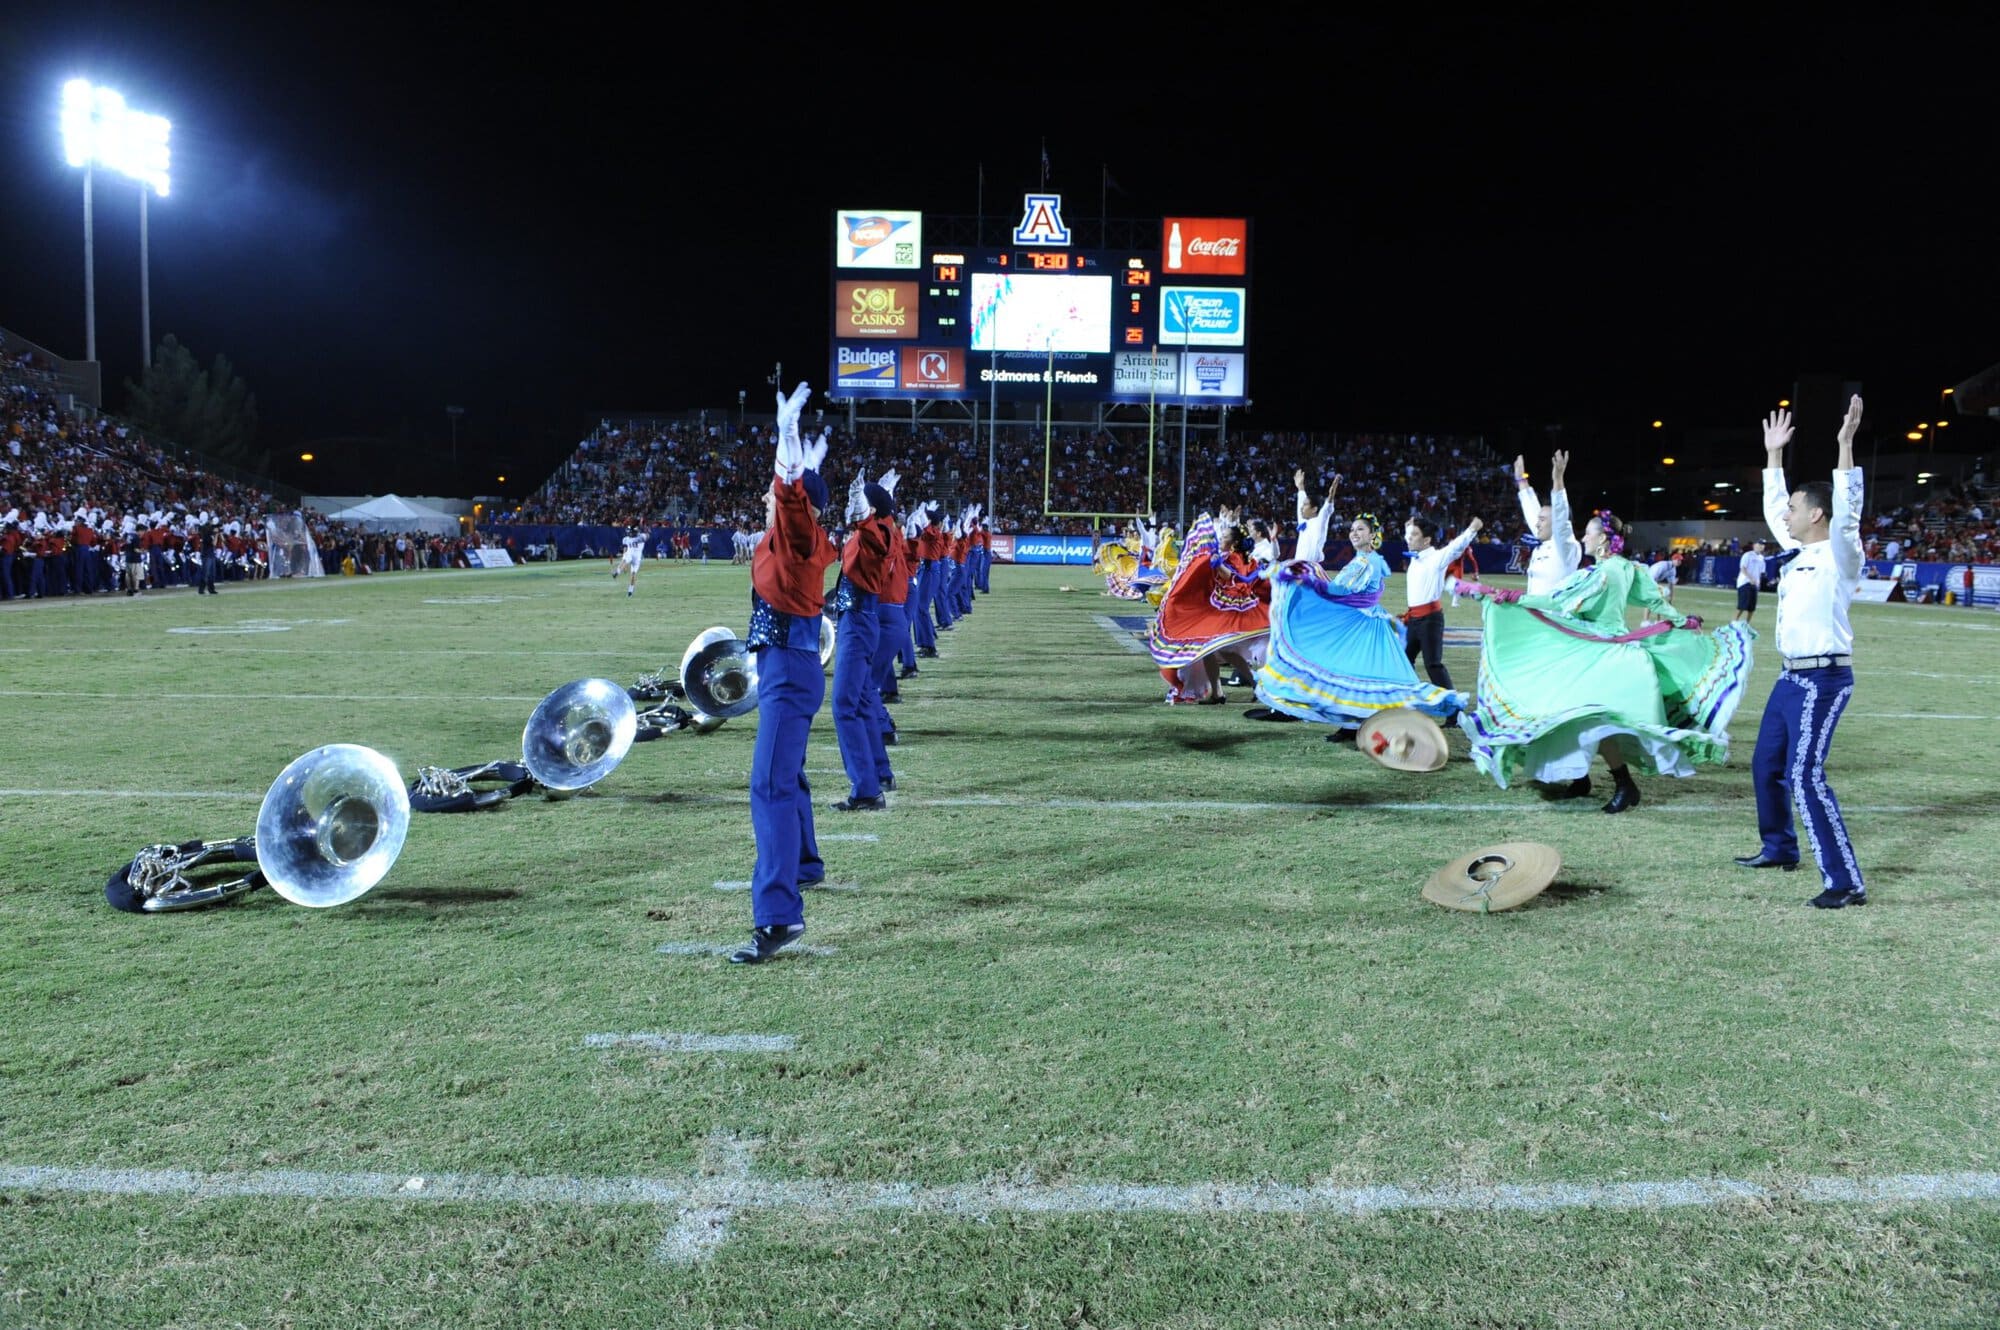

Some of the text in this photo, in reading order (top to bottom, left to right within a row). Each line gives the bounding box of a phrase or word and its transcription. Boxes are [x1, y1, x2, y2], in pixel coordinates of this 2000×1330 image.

[1013, 193, 1071, 246] A
[1000, 255, 1007, 266] 3
[1028, 253, 1068, 269] 7:30
[1077, 257, 1084, 268] 3
[1128, 270, 1150, 286] 24
[851, 288, 905, 314] SOL
[1131, 301, 1140, 313] 3
[1183, 295, 1223, 307] Tucson
[1187, 307, 1233, 318] Electric
[851, 314, 905, 326] CASINOS
[1191, 318, 1233, 329] Power
[838, 347, 895, 369] Budget
[1055, 371, 1098, 384] Friends
[1115, 368, 1176, 382] Daily Star
